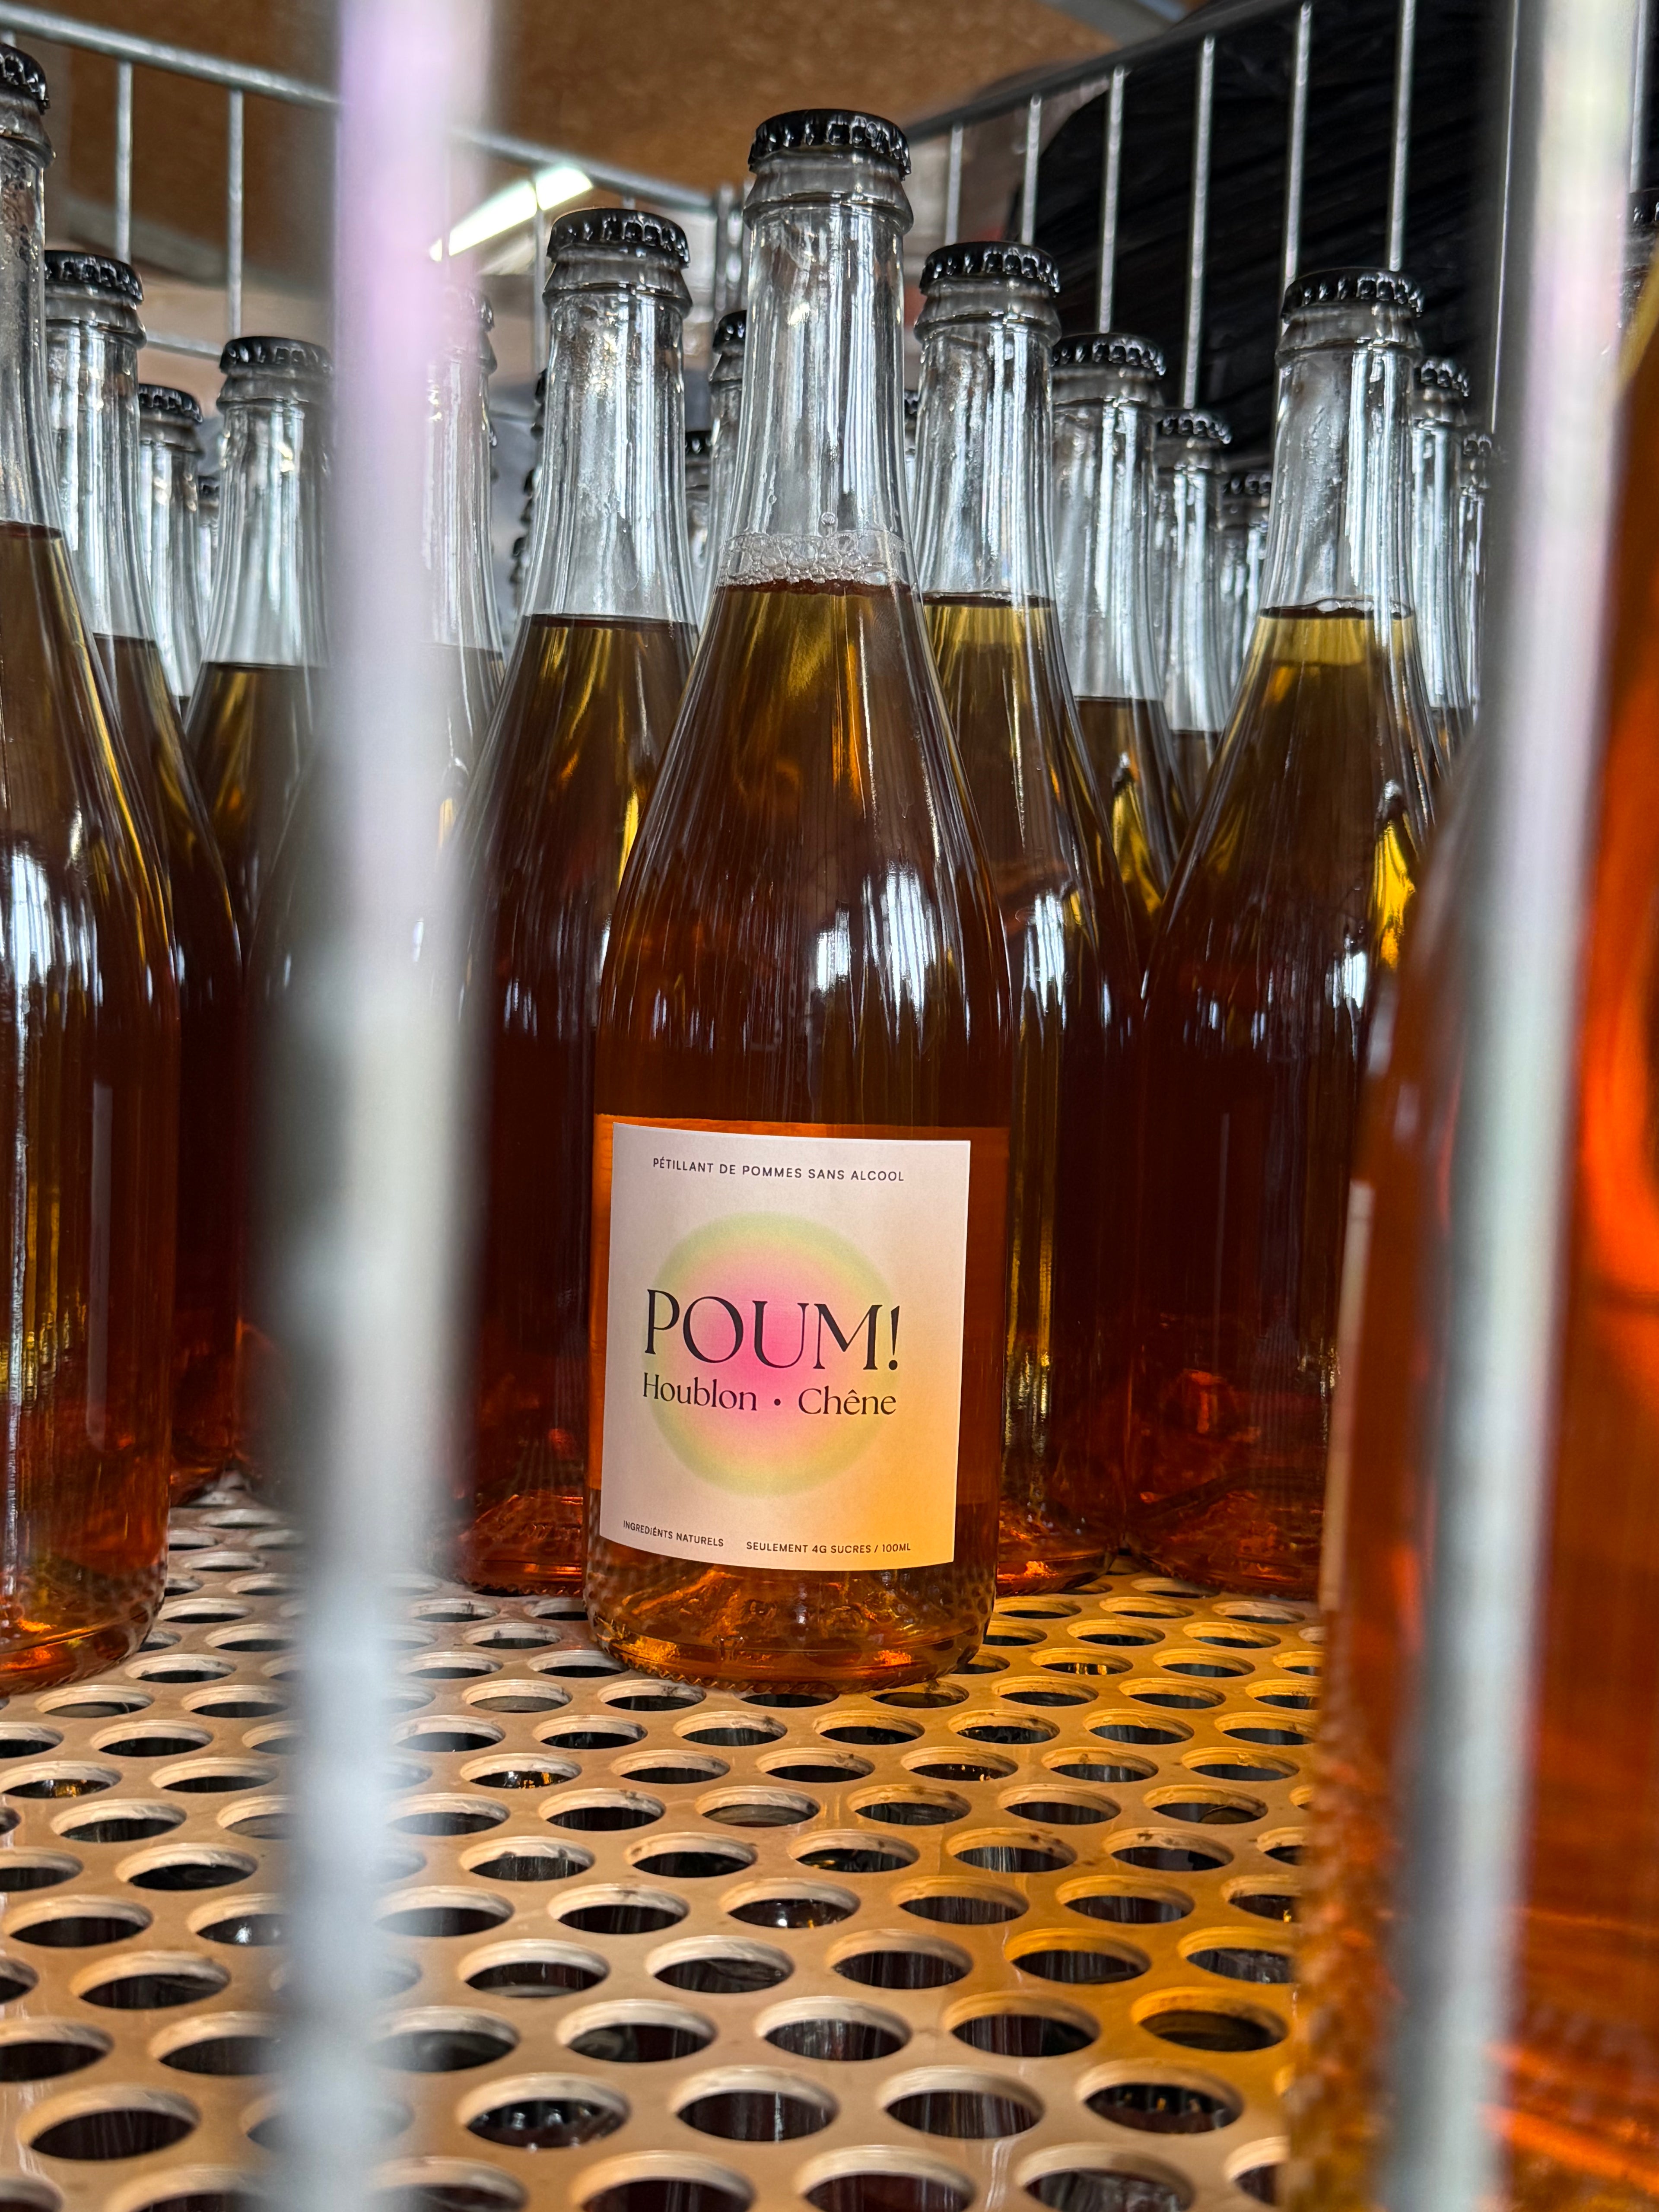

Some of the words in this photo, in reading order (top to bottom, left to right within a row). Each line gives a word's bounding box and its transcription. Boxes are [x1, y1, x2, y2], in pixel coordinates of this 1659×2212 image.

[653, 1157, 714, 1173] PÉTILLANT
[719, 1163, 736, 1175] DE
[742, 1165, 802, 1178] POMMES
[808, 1169, 844, 1180] SANS
[851, 1170, 904, 1181] ALCOOL
[645, 1289, 900, 1370] POUM!
[643, 1372, 757, 1411] Houblon
[798, 1385, 896, 1415] Chêne
[676, 1532, 724, 1547] NATURELS
[746, 1541, 808, 1553] SEULEMENT
[812, 1545, 827, 1554] 4G
[830, 1545, 871, 1554] SUCRES
[882, 1543, 911, 1552] 100ML
